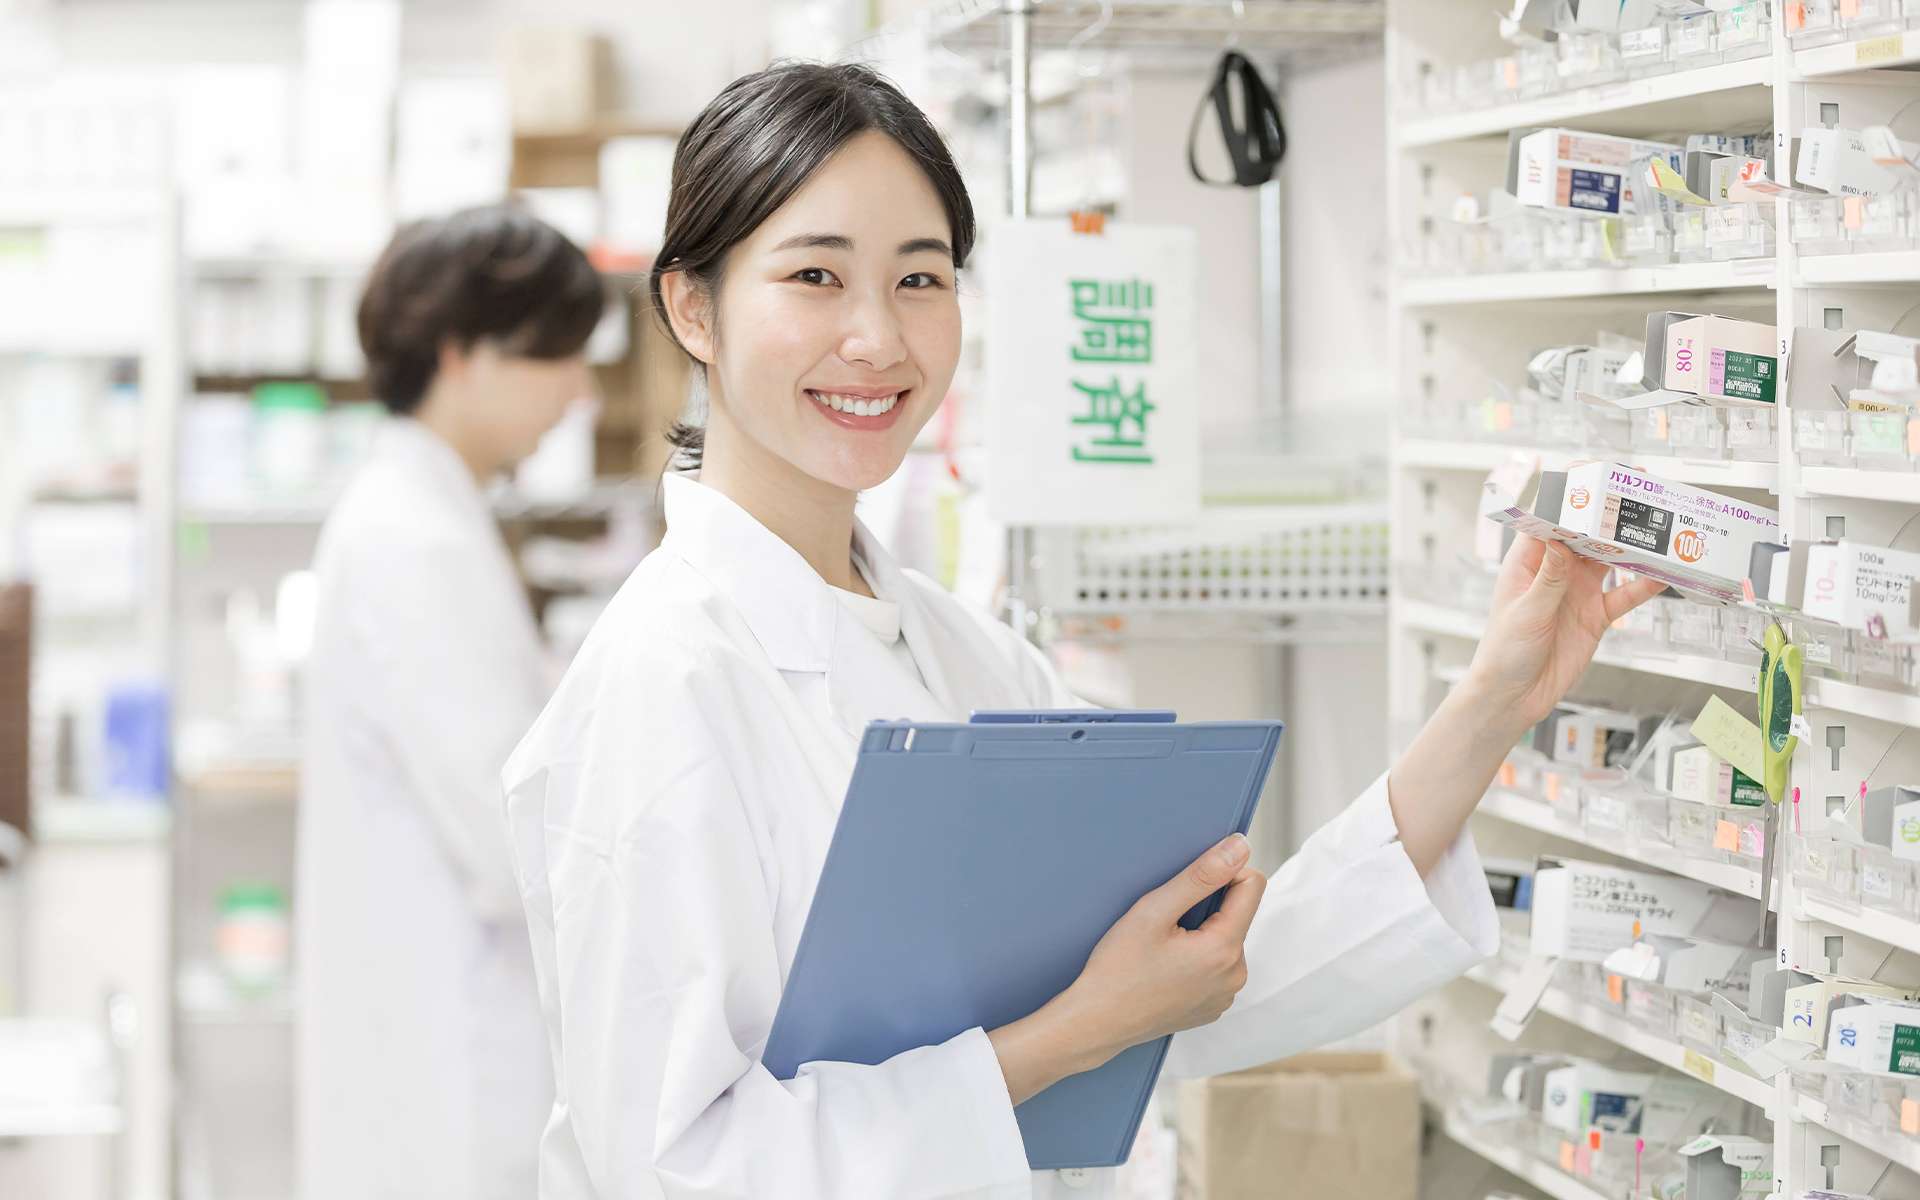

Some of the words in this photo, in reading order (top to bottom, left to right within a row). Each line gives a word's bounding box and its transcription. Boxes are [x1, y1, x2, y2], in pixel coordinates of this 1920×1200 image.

[1781, 340, 1786, 354] 3
[1070, 277, 1155, 464] 調剤
[1781, 949, 1786, 964] 6
